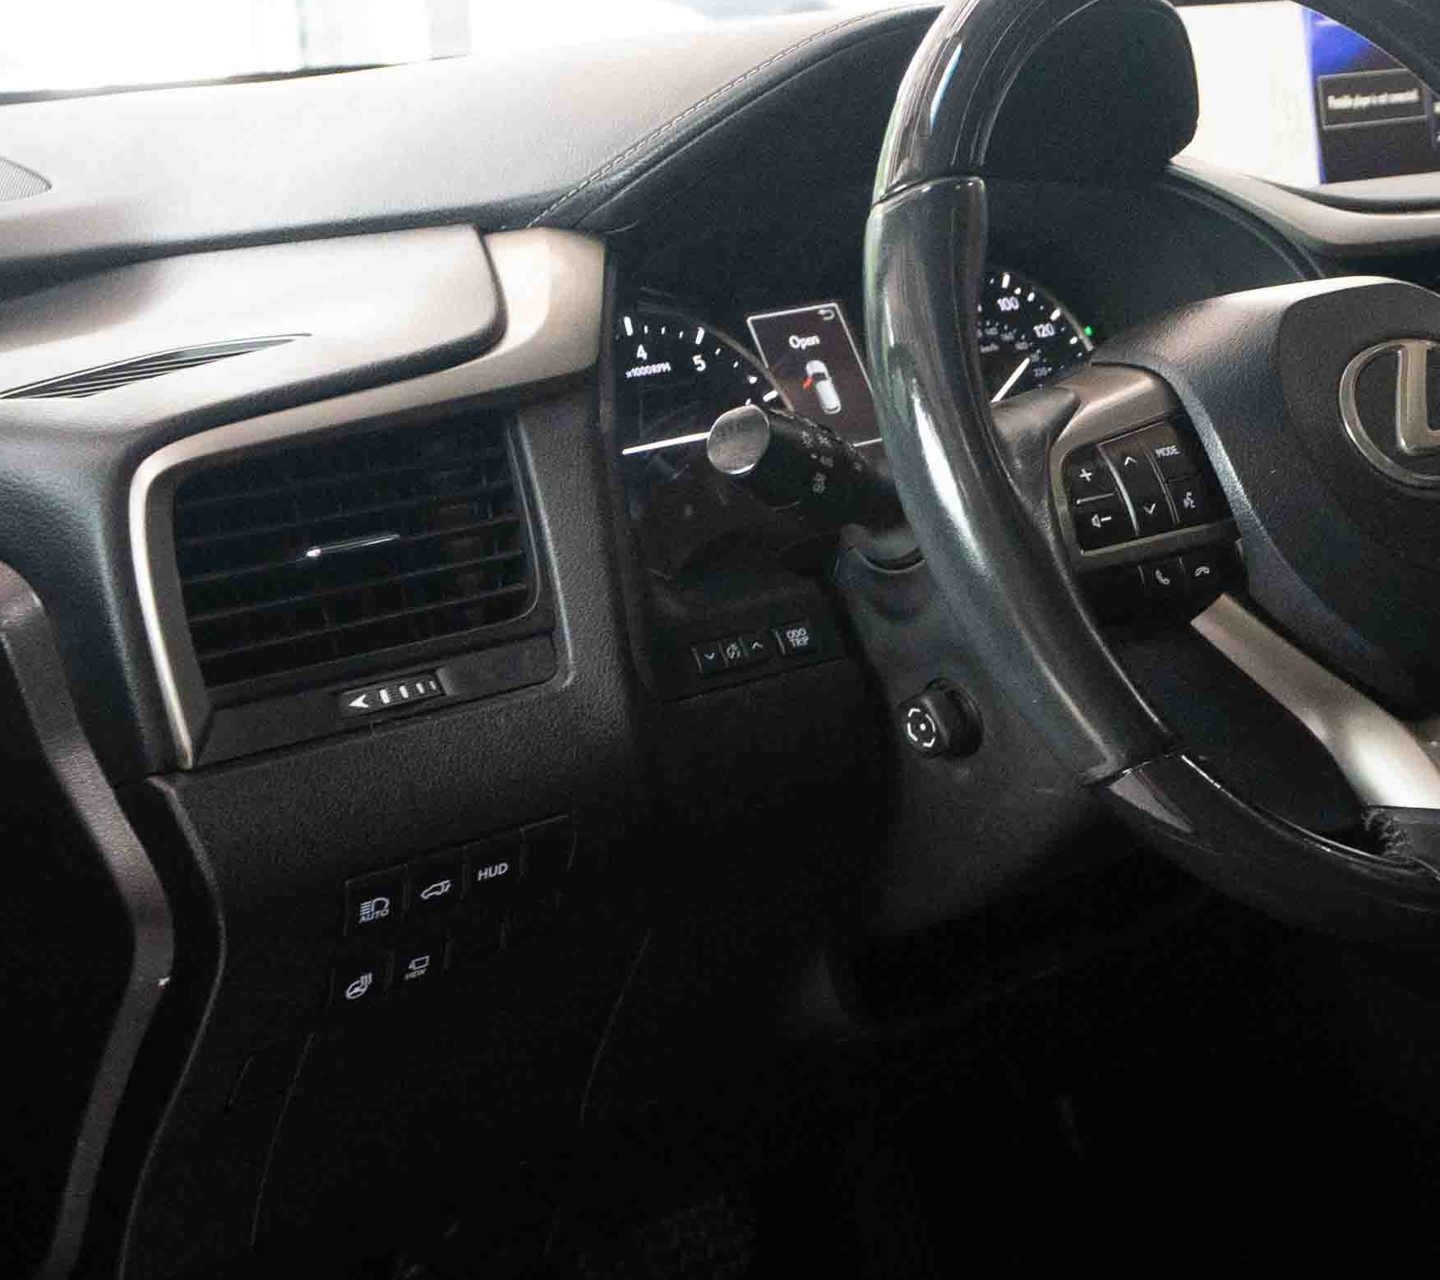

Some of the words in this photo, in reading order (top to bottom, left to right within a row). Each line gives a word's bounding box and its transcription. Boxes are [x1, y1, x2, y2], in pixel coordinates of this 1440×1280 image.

[997, 297, 1019, 311] 100
[1033, 324, 1055, 338] 120
[788, 334, 820, 351] Open
[636, 344, 648, 360] 4
[692, 354, 706, 372] 5
[1155, 445, 1180, 458] MODE
[477, 862, 509, 881] HUD
[359, 908, 390, 923] AUTO
